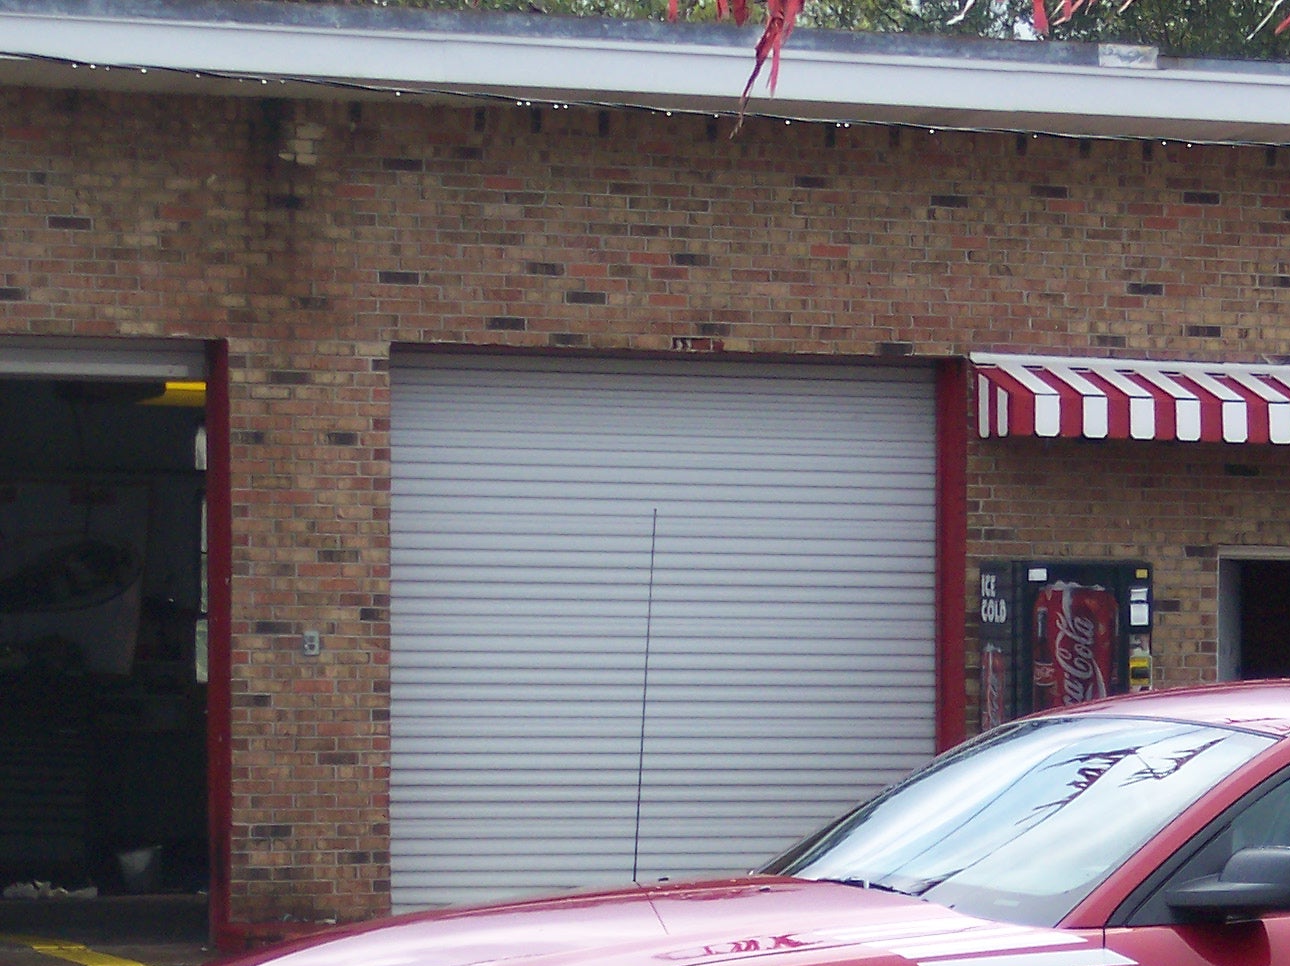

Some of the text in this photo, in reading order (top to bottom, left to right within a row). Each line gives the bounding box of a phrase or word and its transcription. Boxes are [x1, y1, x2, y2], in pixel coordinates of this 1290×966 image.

[981, 574, 997, 598] ICE
[981, 599, 1007, 624] COLD
[1055, 612, 1098, 706] ca-Cola
